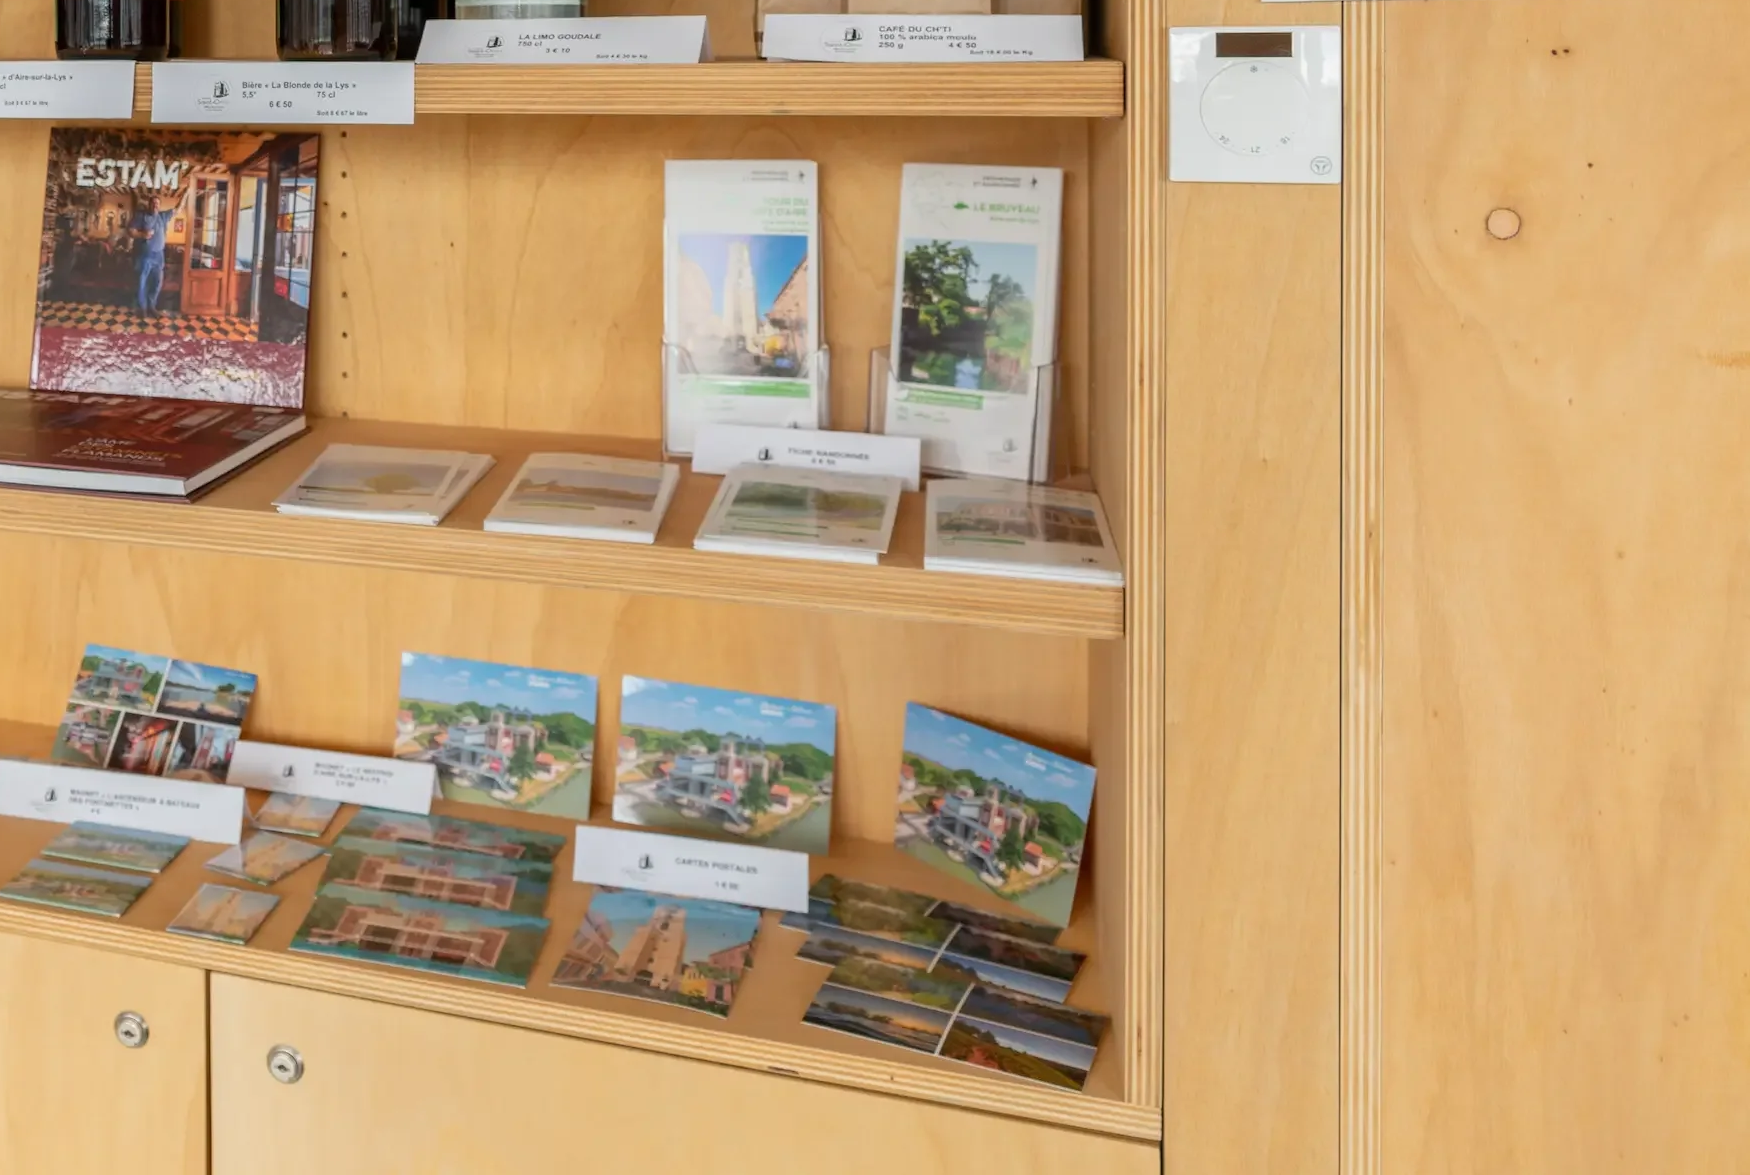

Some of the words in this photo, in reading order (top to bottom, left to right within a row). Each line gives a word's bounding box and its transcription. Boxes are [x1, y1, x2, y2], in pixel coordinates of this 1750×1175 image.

[879, 24, 905, 33] CAFÉ
[924, 25, 952, 33] CH'TI
[8, 73, 66, 83] d'Aire-sur-la-Lys
[0, 82, 6, 90] cl
[242, 81, 262, 90] Bière
[271, 82, 282, 90] La
[283, 81, 312, 90] Blonde
[314, 81, 324, 90] de
[325, 81, 333, 90] la
[335, 82, 350, 92] Lys
[328, 90, 335, 98] cl
